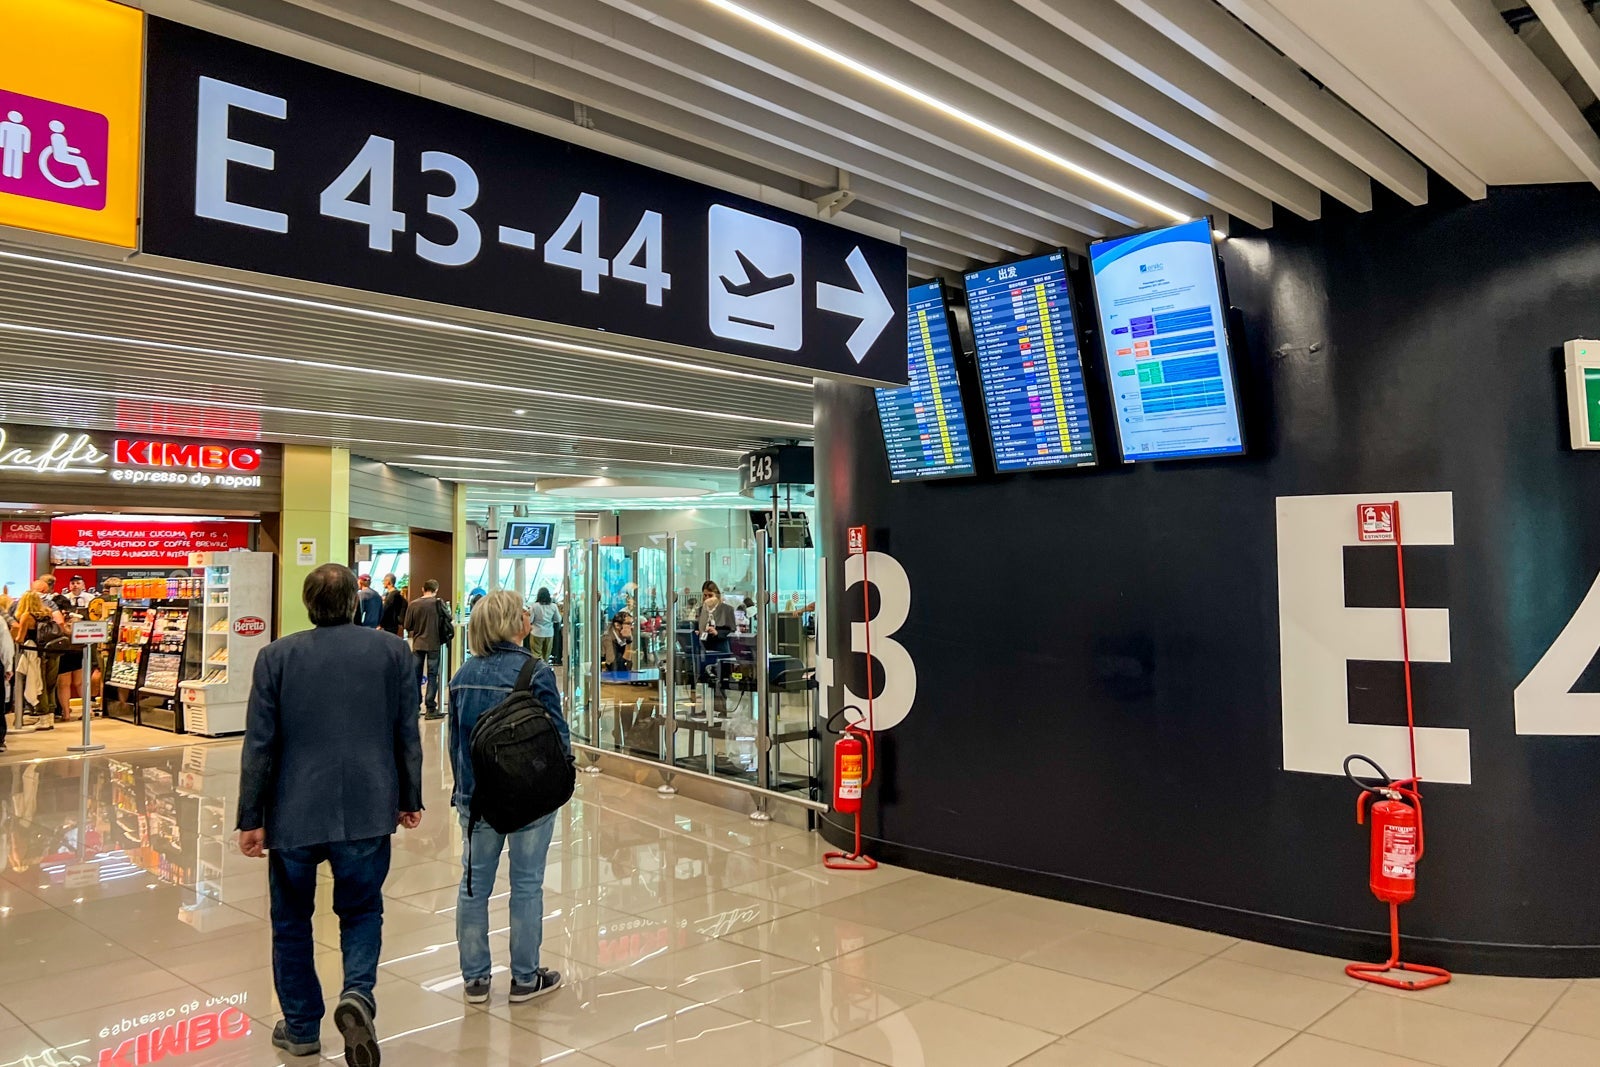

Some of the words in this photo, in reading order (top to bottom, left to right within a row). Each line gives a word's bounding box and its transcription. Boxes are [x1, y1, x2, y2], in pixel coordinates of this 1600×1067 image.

[196, 76, 289, 233] E
[319, 135, 671, 308] 43-44
[998, 266, 1017, 280] 出发
[115, 439, 260, 471] KIMBO
[750, 455, 772, 483] E43
[112, 469, 188, 484] espresso
[190, 472, 211, 486] da
[215, 475, 261, 488] napoli
[10, 524, 42, 532] CASSA
[78, 529, 93, 537] THE
[234, 621, 265, 632] Beretta
